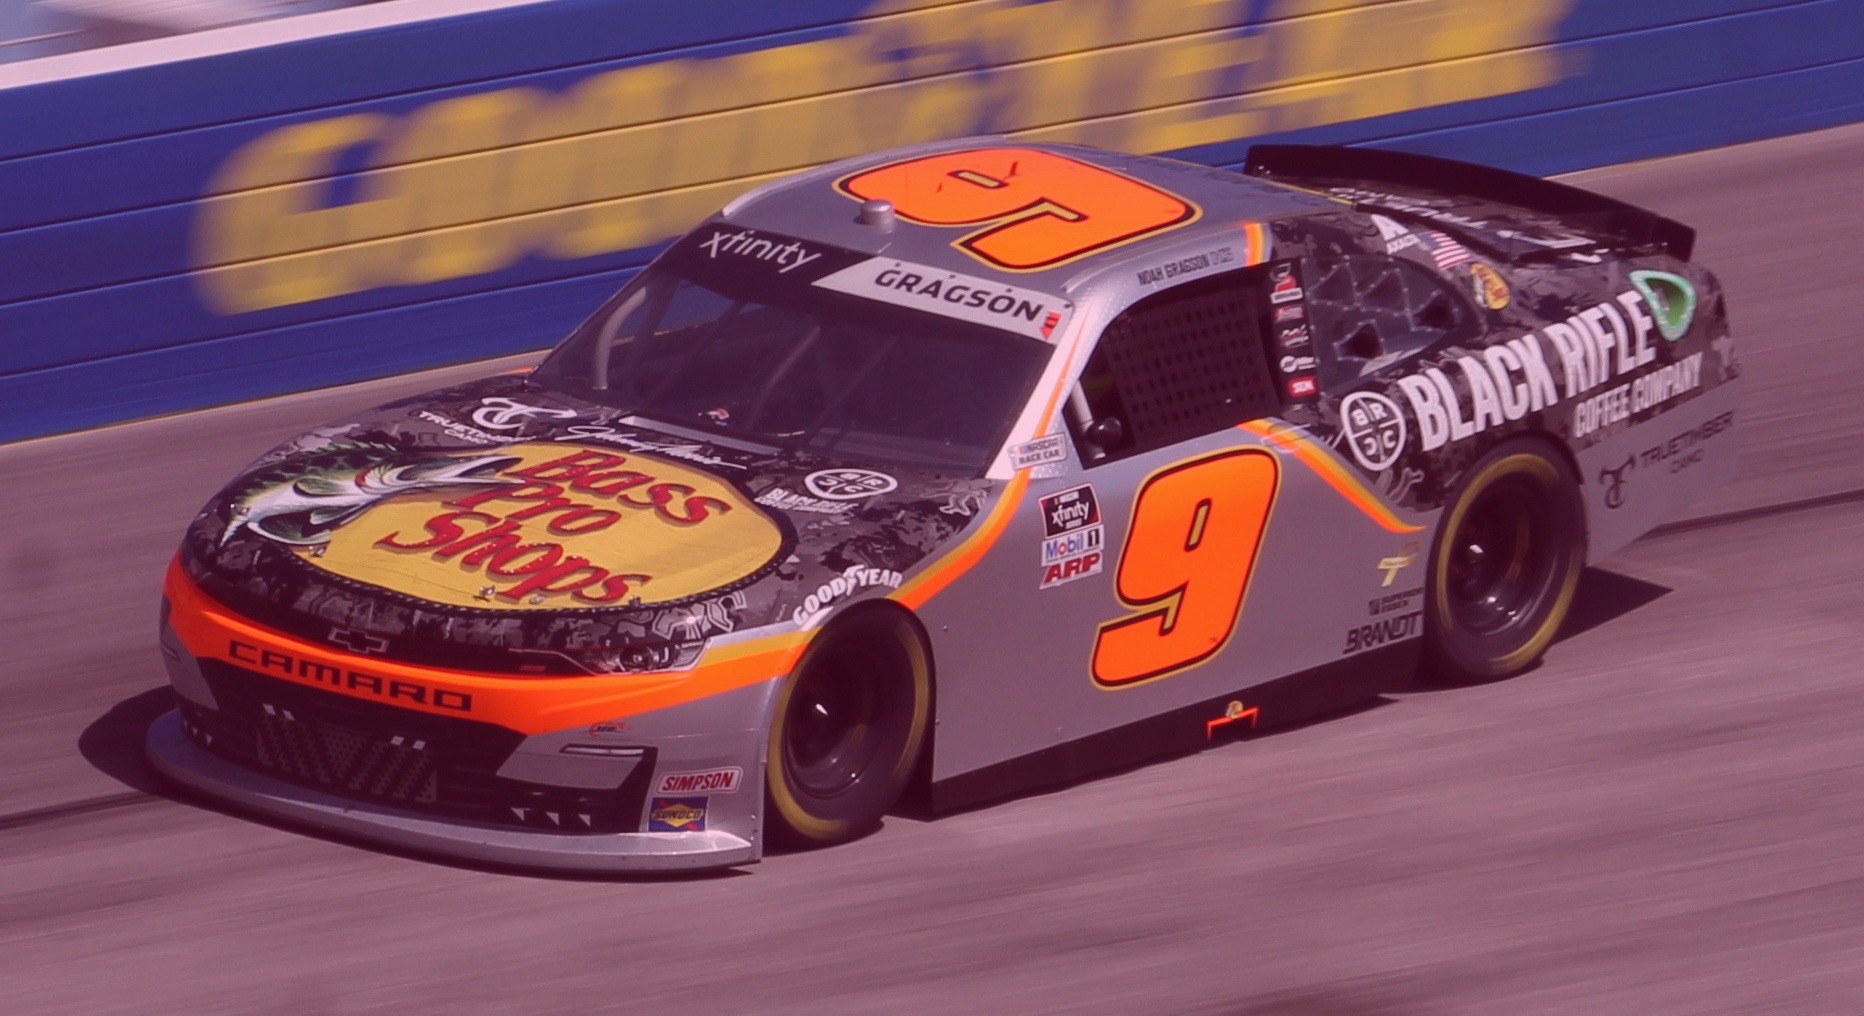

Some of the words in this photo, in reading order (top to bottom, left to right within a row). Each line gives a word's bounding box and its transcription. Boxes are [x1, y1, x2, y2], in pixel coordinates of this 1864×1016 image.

[832, 147, 1203, 274] 9
[699, 230, 822, 274] xfinity
[1137, 266, 1165, 286] NOAH
[874, 268, 1045, 323] GRAGSON
[1397, 333, 1558, 452] BLACK
[1543, 289, 1656, 399] RIFLE
[1572, 382, 1631, 438] COFFEE
[1018, 452, 1041, 465] RACE
[1043, 448, 1060, 460] CAR
[442, 479, 622, 537] Pro
[502, 449, 733, 526] Bass
[1050, 500, 1090, 528] xfinity
[372, 510, 654, 604] Shops
[1044, 552, 1101, 584] ARP
[1046, 531, 1084, 559] Mobil
[1087, 529, 1101, 548] 1
[1089, 444, 1282, 691] 9
[793, 564, 902, 626] GOODYEAR
[1342, 610, 1423, 655] BRANDT
[229, 639, 472, 712] CAMARO
[662, 771, 734, 792] SIMPSON
[650, 808, 704, 821] SUNOCO
